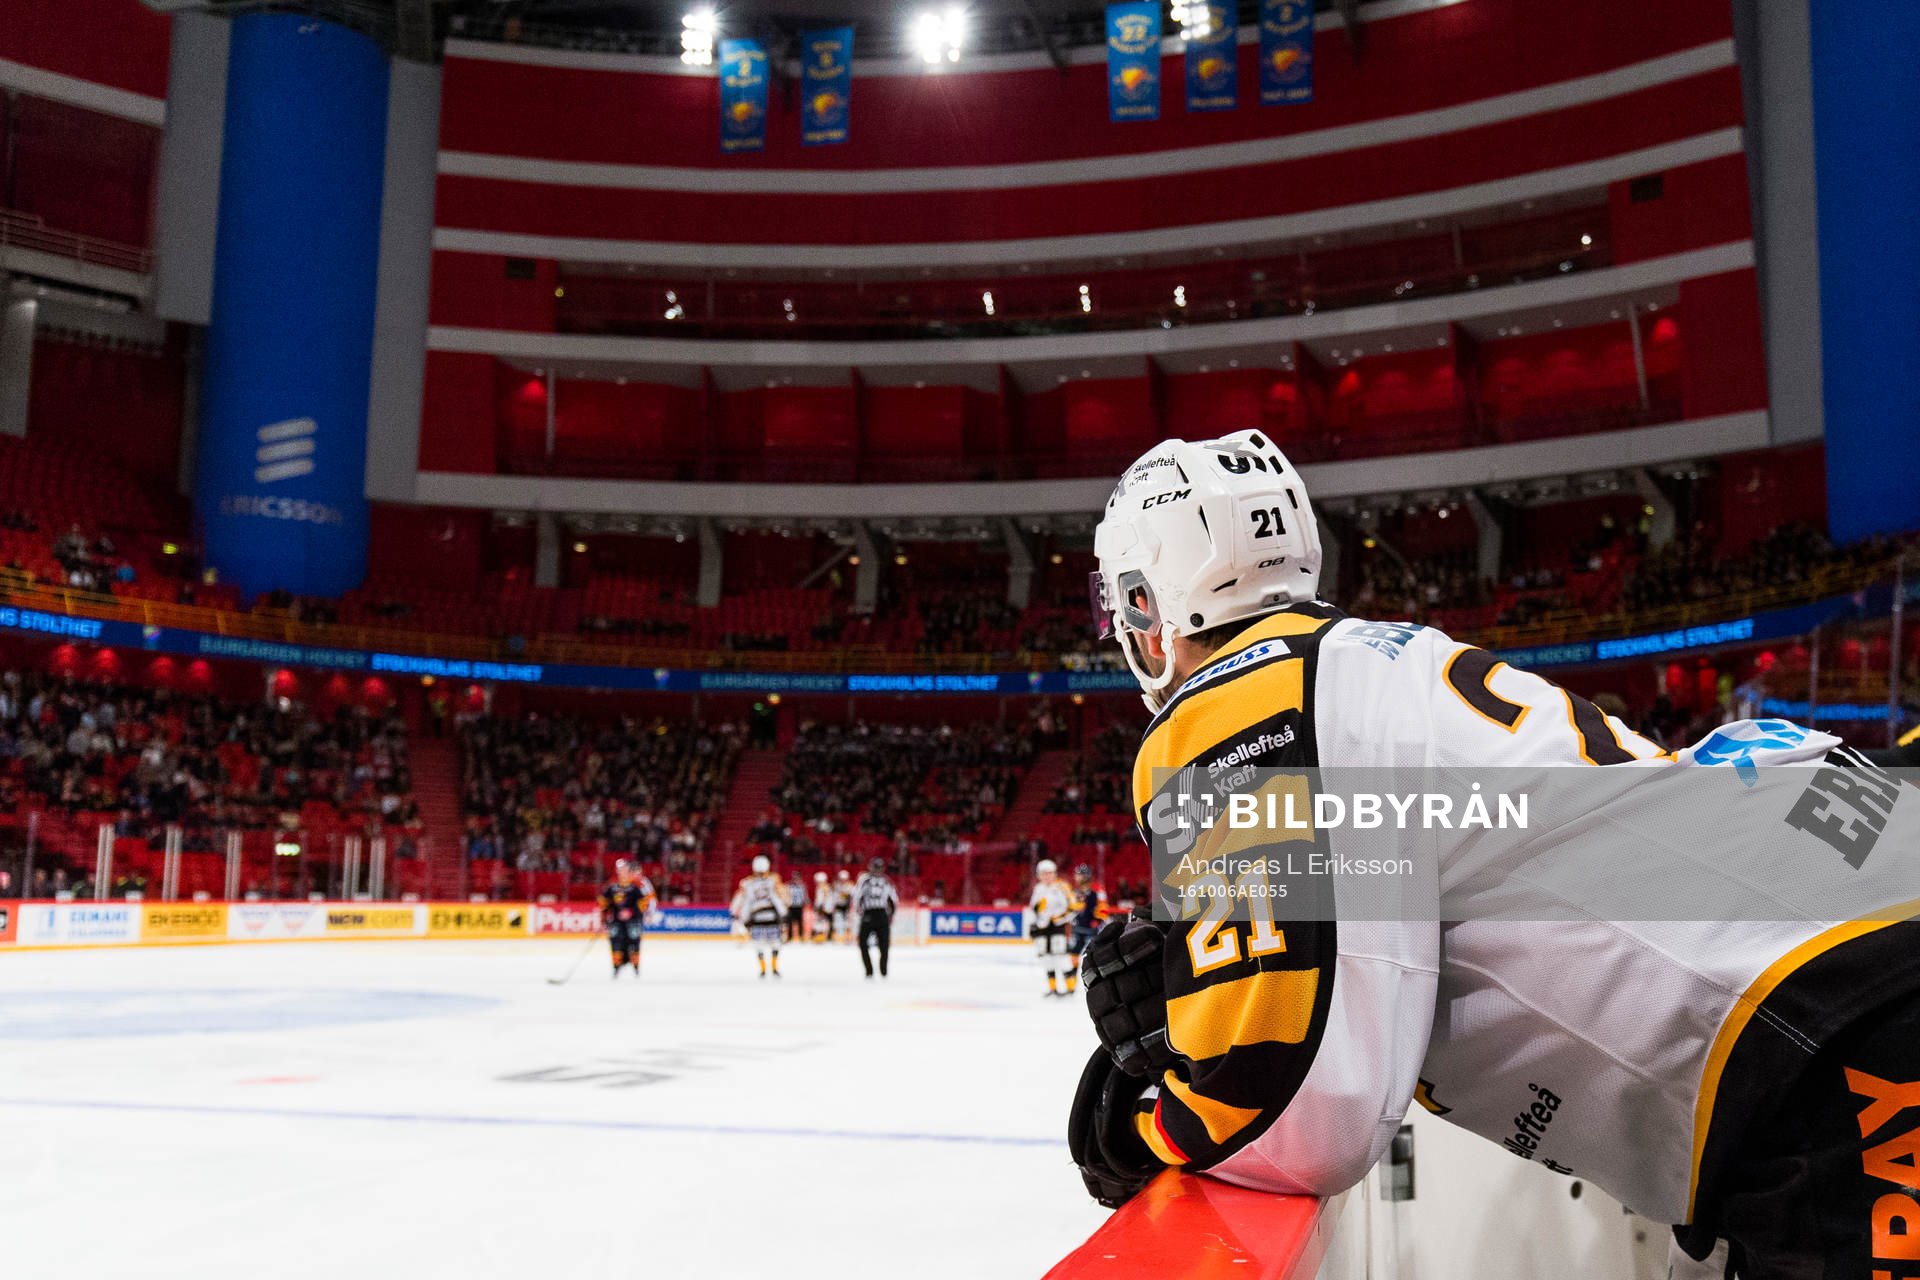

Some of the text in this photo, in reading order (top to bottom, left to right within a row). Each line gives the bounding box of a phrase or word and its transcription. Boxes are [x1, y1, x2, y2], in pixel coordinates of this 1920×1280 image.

[1142, 488, 1192, 510] CCM
[1251, 507, 1286, 539] 21
[1208, 725, 1295, 779] Skellefteå
[1214, 764, 1257, 798] Kraft
[1181, 856, 1287, 977] 21
